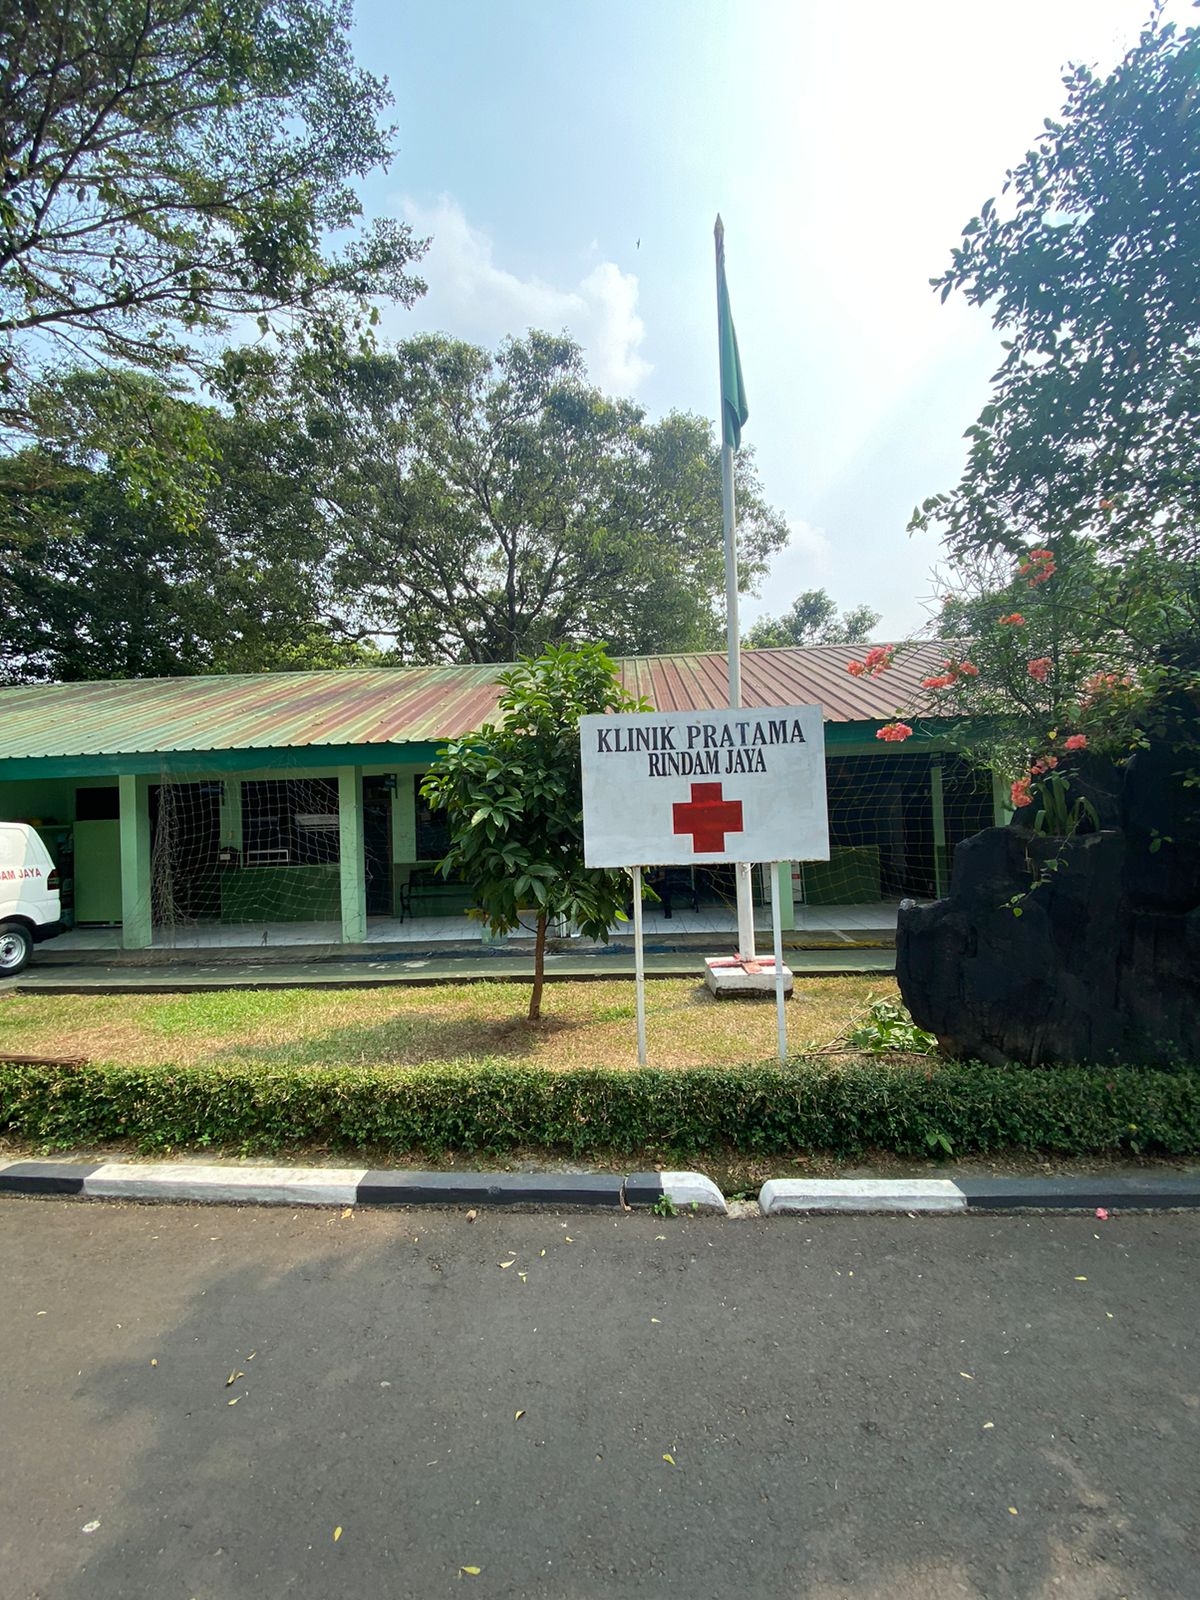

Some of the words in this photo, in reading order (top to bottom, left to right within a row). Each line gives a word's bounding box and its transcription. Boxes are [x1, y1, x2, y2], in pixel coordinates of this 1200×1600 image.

[597, 726, 676, 753] KLINIK
[686, 719, 806, 750] PRATAMA
[648, 751, 721, 777] RINDAM
[725, 748, 767, 774] JAYA
[18, 868, 41, 879] JAYA
